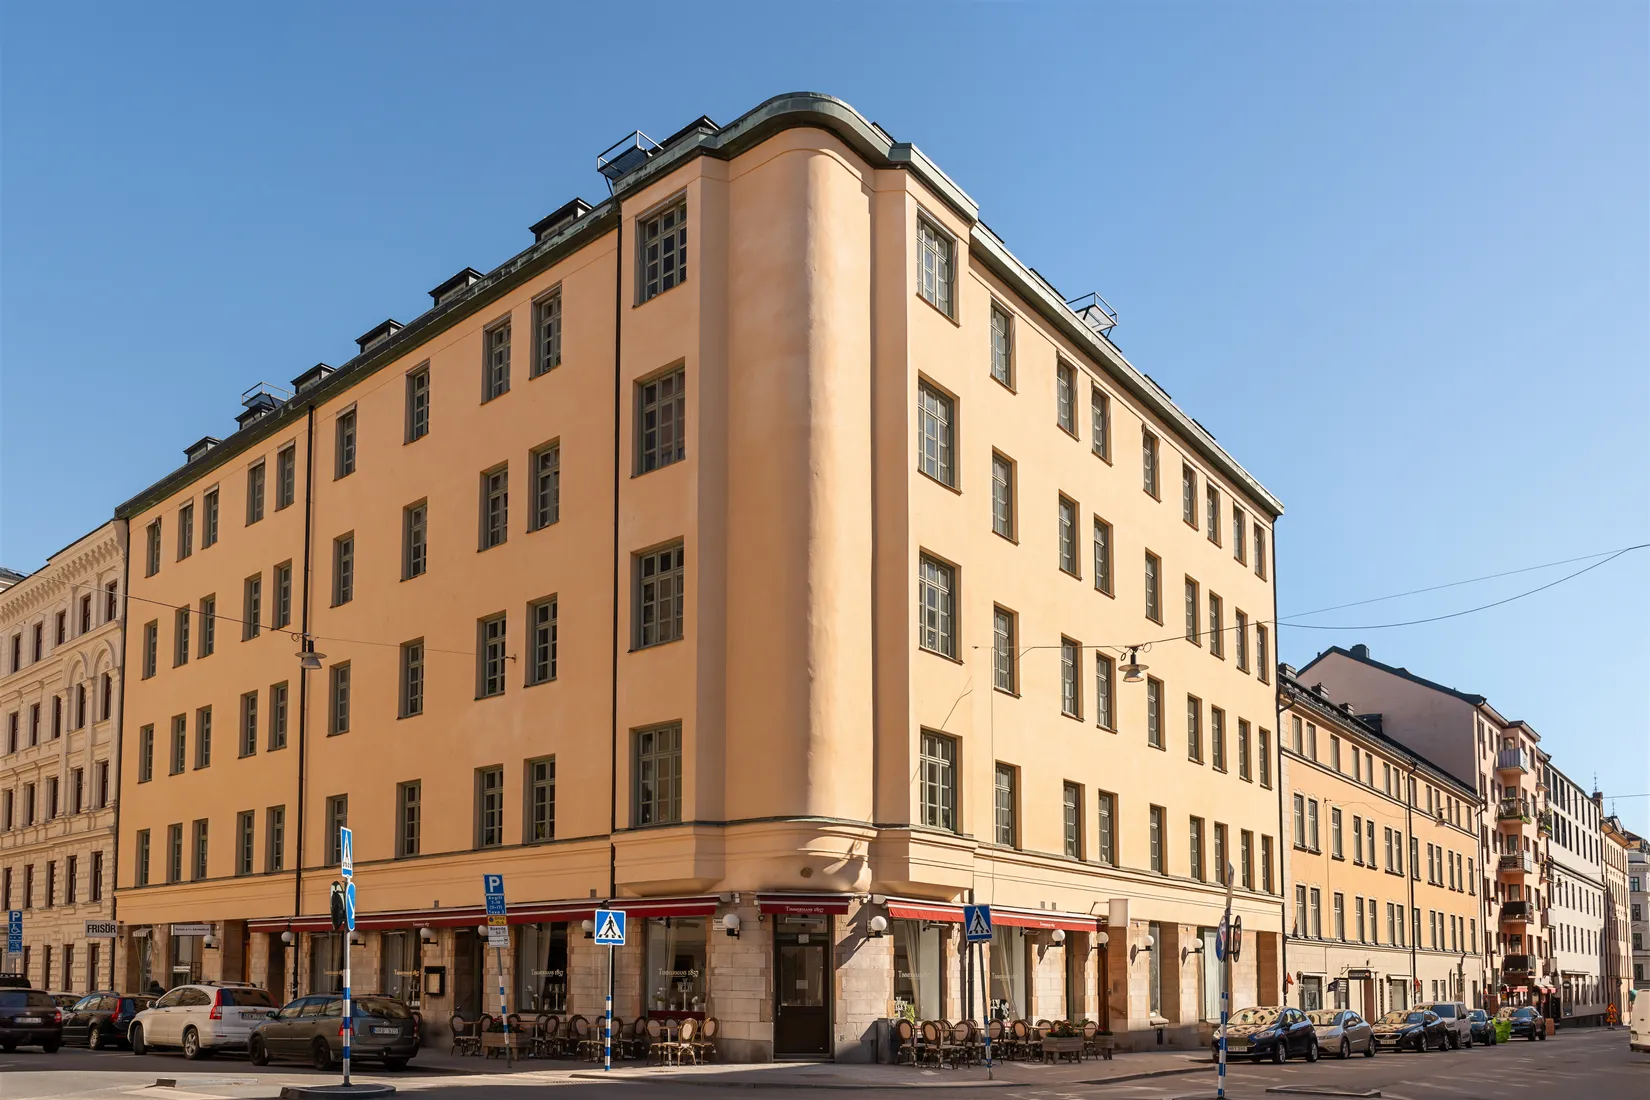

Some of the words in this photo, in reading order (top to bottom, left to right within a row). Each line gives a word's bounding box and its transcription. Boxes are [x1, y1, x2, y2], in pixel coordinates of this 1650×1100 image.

[489, 876, 500, 893] P
[12, 911, 21, 922] P
[87, 923, 116, 934] FRISÖR
